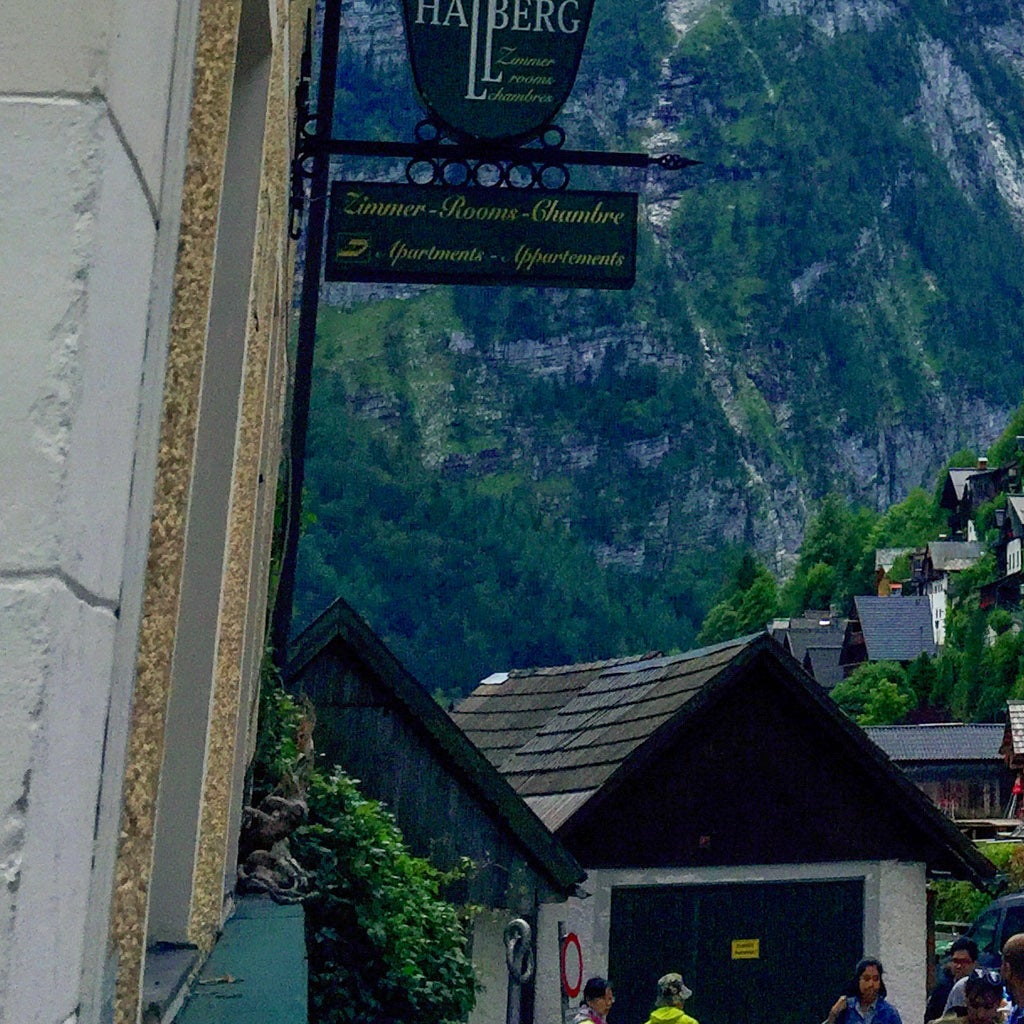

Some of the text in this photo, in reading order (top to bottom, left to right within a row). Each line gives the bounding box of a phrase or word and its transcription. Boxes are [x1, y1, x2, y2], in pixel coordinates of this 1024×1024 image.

[496, 46, 556, 67] Zimmer
[508, 74, 554, 85] rooms
[375, 239, 484, 266] Apartments
[501, 244, 626, 270] Appartements
